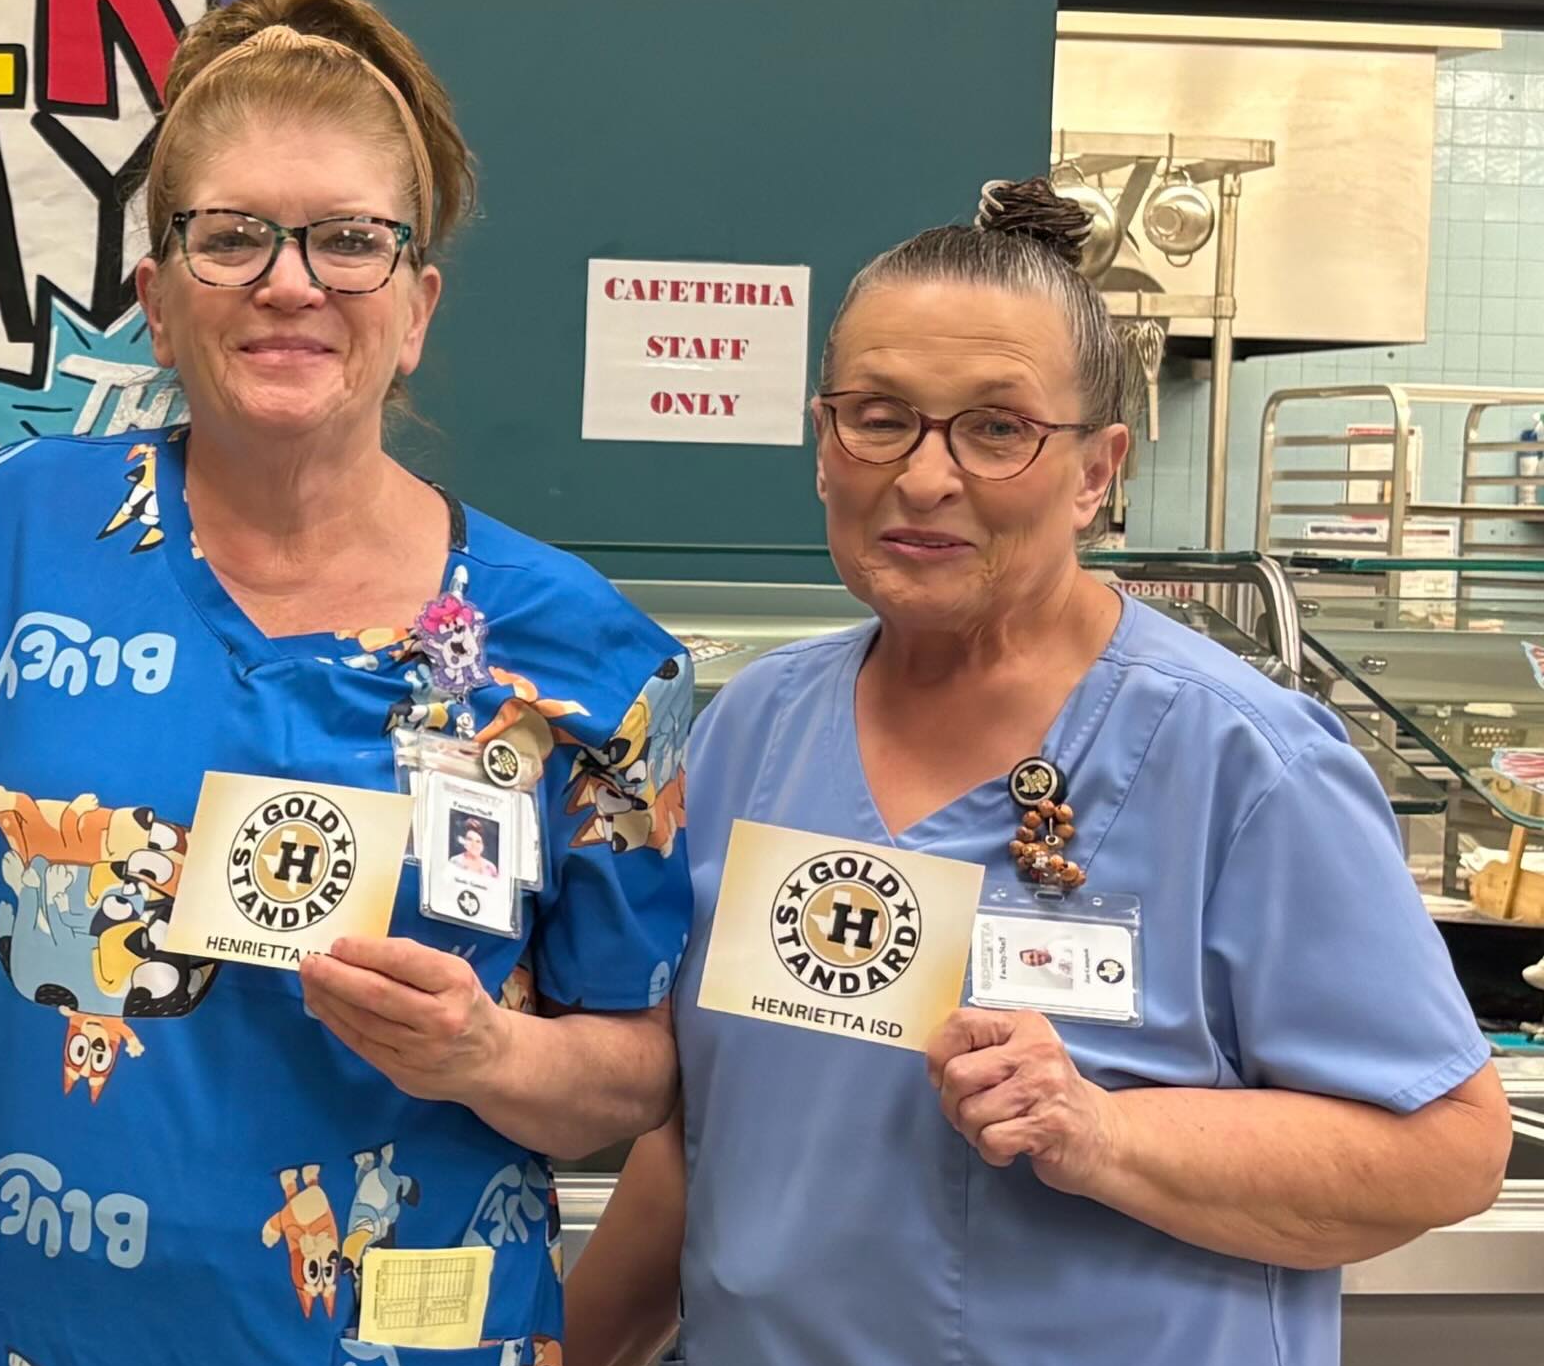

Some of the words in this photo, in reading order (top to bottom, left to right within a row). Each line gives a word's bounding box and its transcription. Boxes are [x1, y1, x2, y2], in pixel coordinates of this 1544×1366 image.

[604, 276, 795, 307] CAFETERIA
[646, 335, 749, 361] STAFF
[650, 391, 740, 416] ONLY
[262, 797, 340, 834] GOLD
[274, 840, 321, 885] H
[808, 856, 900, 898] GOLD
[232, 847, 352, 928] STANDARD
[827, 901, 879, 950] H
[205, 935, 301, 963] HENRIETTA
[776, 904, 918, 995] STANDARD
[751, 995, 866, 1032] HENRIETTA
[869, 1018, 903, 1039] ISD
